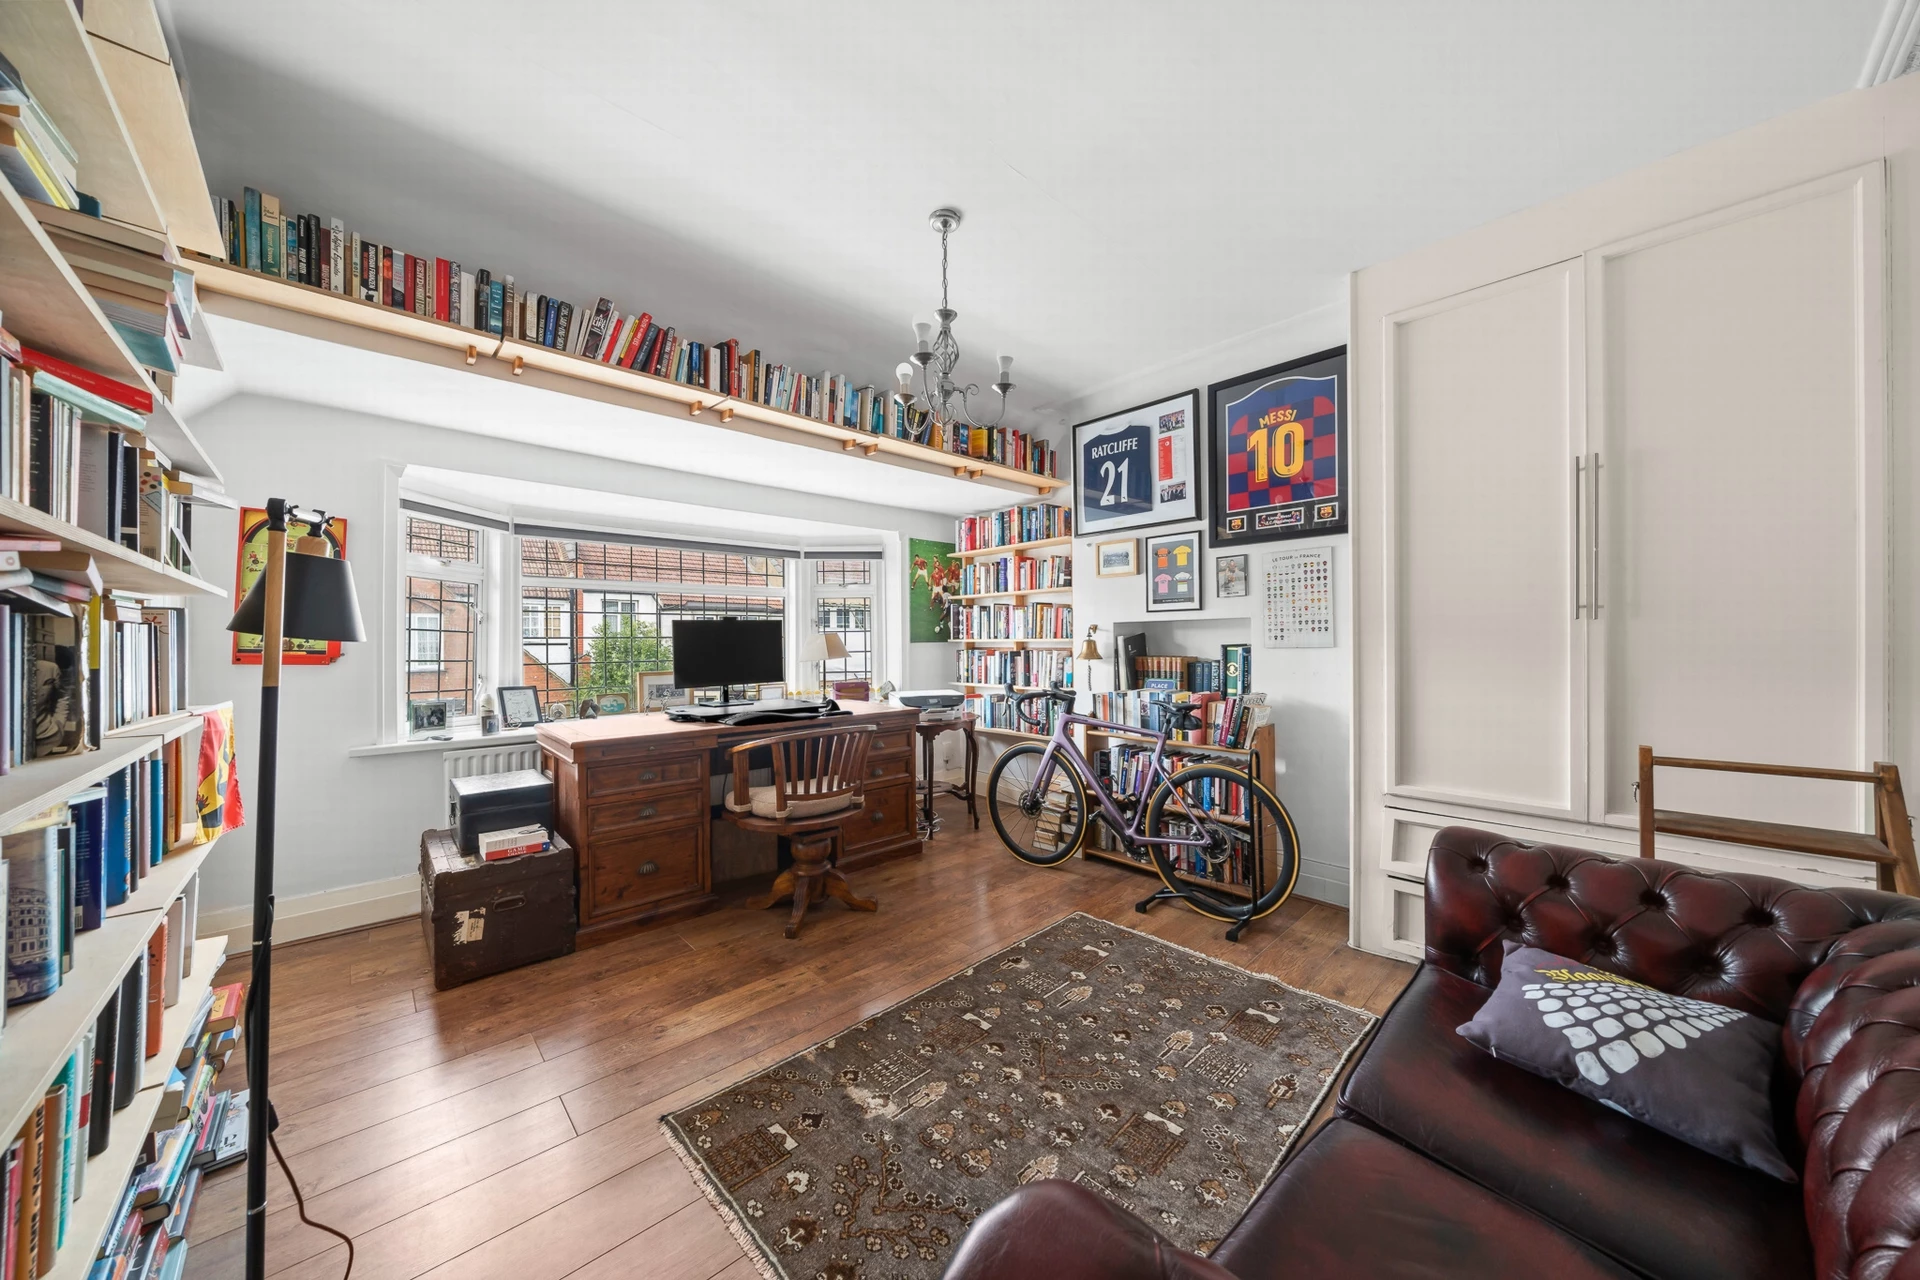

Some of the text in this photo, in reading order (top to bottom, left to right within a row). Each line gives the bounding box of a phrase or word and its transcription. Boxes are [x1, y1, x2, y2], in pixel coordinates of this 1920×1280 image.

[266, 227, 275, 264] Margaret Atwood
[368, 245, 376, 290] JONATHAN FRANZEN
[592, 319, 606, 330] LIFE
[1258, 409, 1298, 428] MESSI
[1091, 437, 1139, 459] RATCLIFFE
[1247, 422, 1305, 482] 10
[1100, 457, 1129, 506] 21
